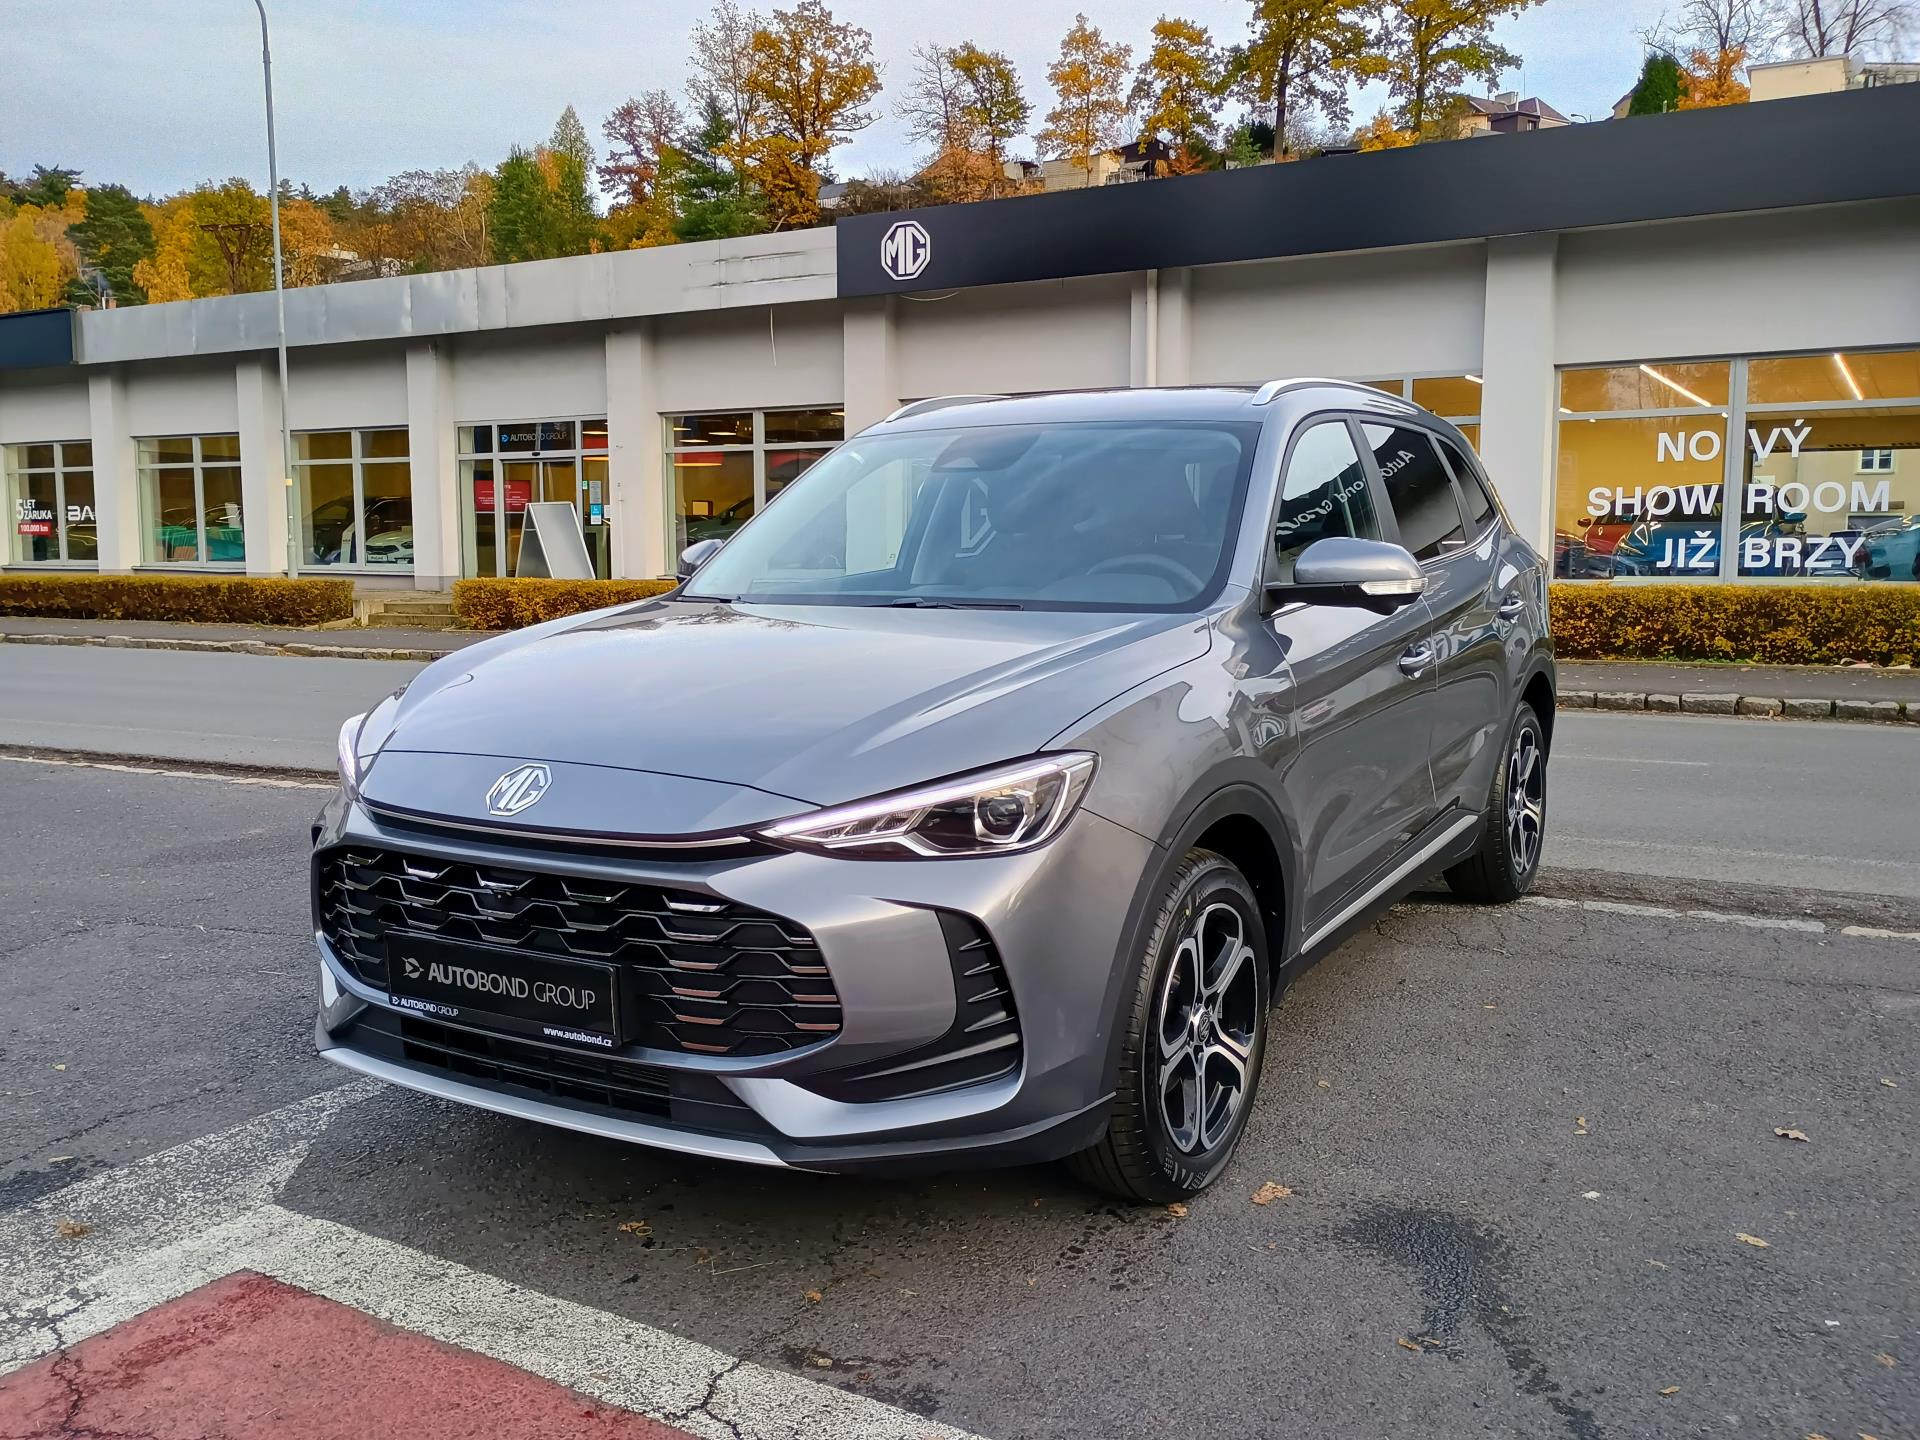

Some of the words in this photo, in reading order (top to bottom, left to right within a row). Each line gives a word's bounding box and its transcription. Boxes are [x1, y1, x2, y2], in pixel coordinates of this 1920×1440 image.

[885, 225, 926, 275] MG
[510, 432, 545, 441] AUTOBOD
[16, 498, 24, 520] 5
[23, 499, 36, 509] LET
[1587, 485, 1719, 517] SHOW
[1746, 480, 1890, 513] ROOM
[20, 524, 40, 532] 100.000
[40, 524, 49, 532] km
[1656, 530, 1716, 568] JIŽ
[1743, 537, 1866, 569] BRZY
[491, 767, 546, 811] MG
[428, 962, 529, 998] AUTOBOND
[533, 982, 596, 1010] GROUP
[400, 997, 437, 1012] AUTOBOND
[437, 1005, 459, 1016] GROUP
[543, 1027, 613, 1047] www.autobond.cz
